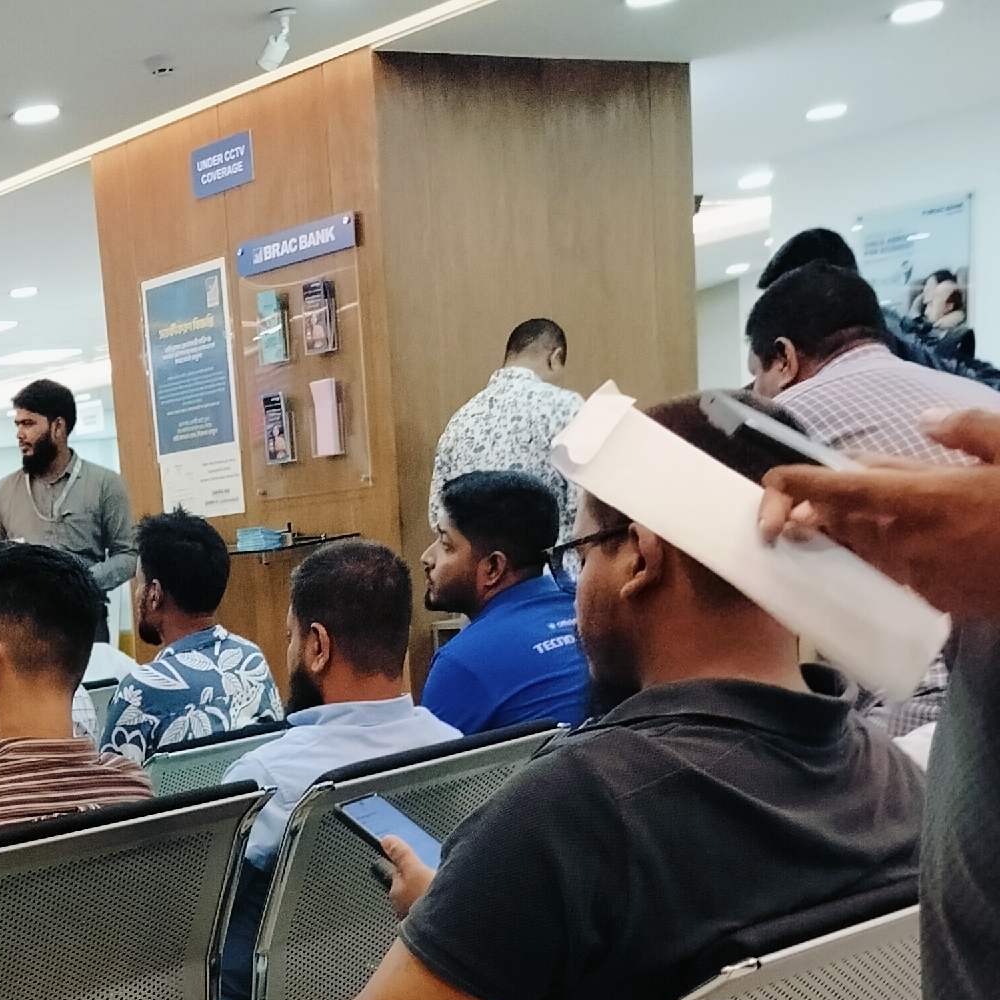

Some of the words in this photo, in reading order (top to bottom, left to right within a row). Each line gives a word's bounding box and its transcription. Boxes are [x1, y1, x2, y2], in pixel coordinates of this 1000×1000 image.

[197, 153, 223, 171] UNDER
[224, 145, 246, 161] CCTV
[201, 161, 244, 185] COVERAGE
[263, 238, 298, 261] BRAC
[299, 226, 336, 251] BANK
